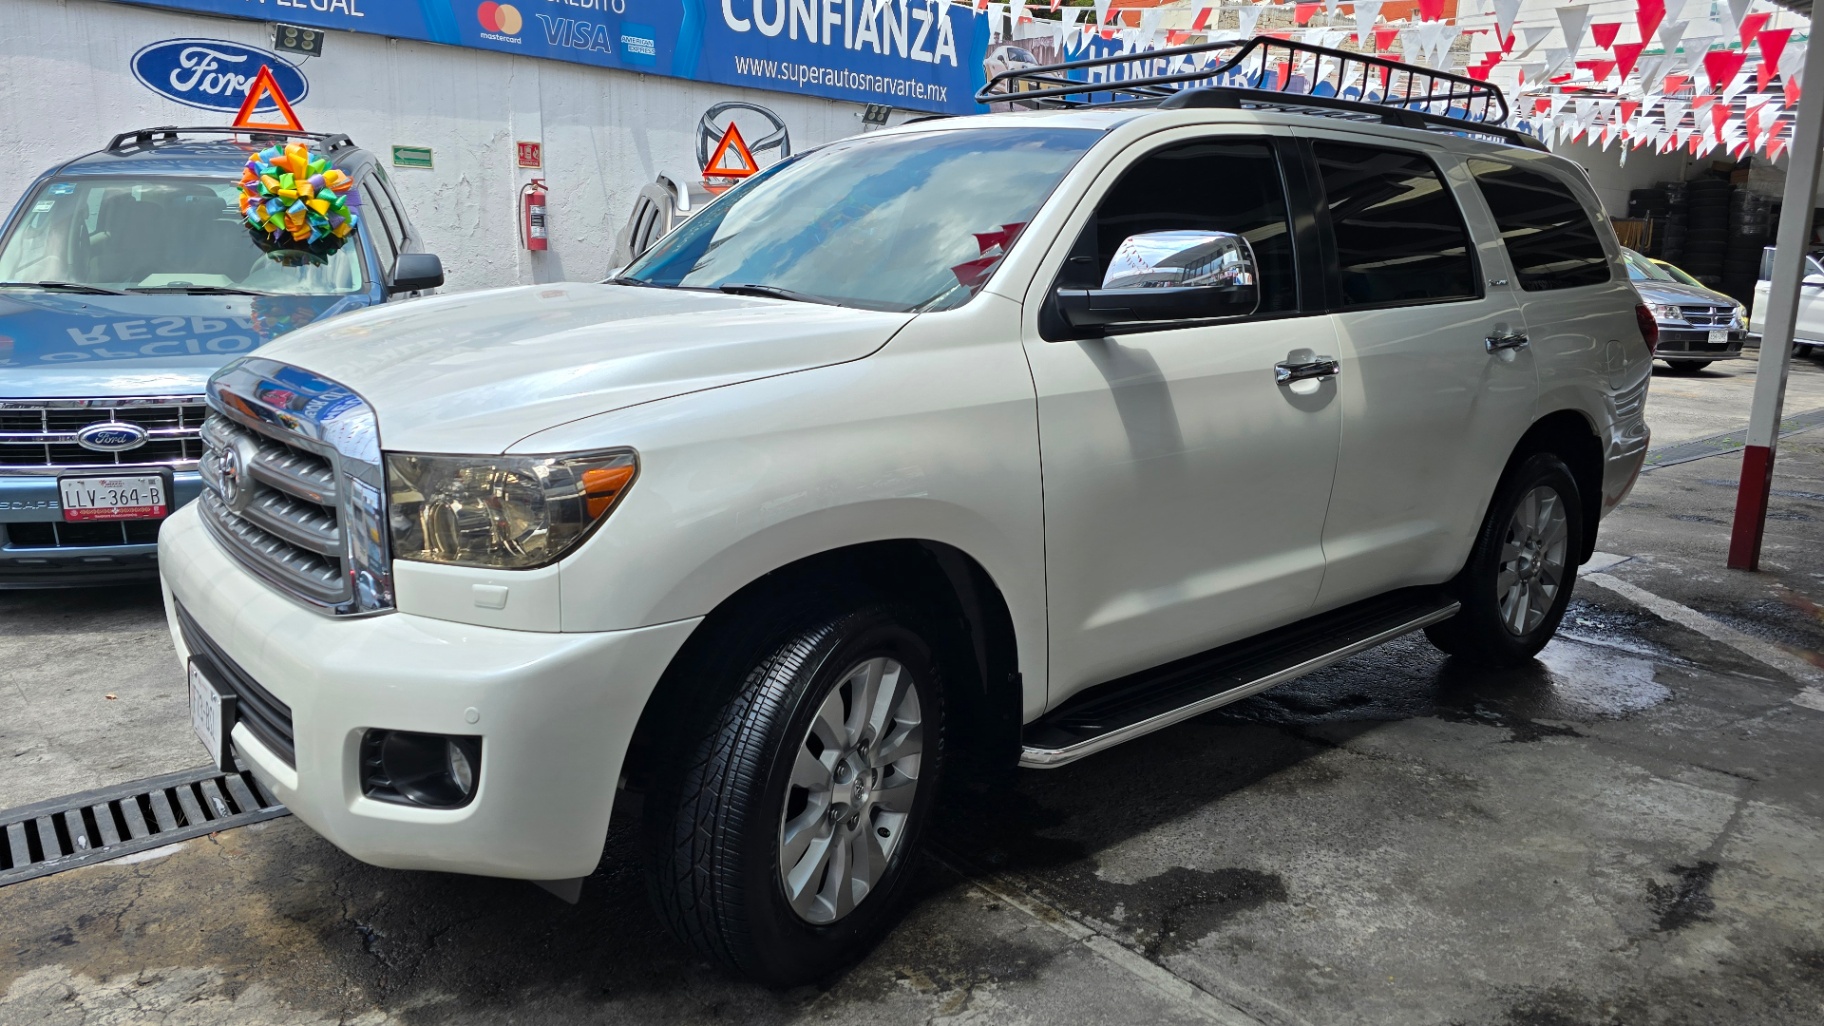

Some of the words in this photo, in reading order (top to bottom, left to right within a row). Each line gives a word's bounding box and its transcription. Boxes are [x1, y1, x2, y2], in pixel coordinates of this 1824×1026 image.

[480, 32, 522, 44] mastercard
[535, 13, 612, 53] VISA
[621, 35, 655, 47] AMERICAN
[735, 55, 948, 102] www.superautosnarvarte.mx
[94, 431, 127, 444] Ford
[65, 487, 161, 508] LLV-364-B
